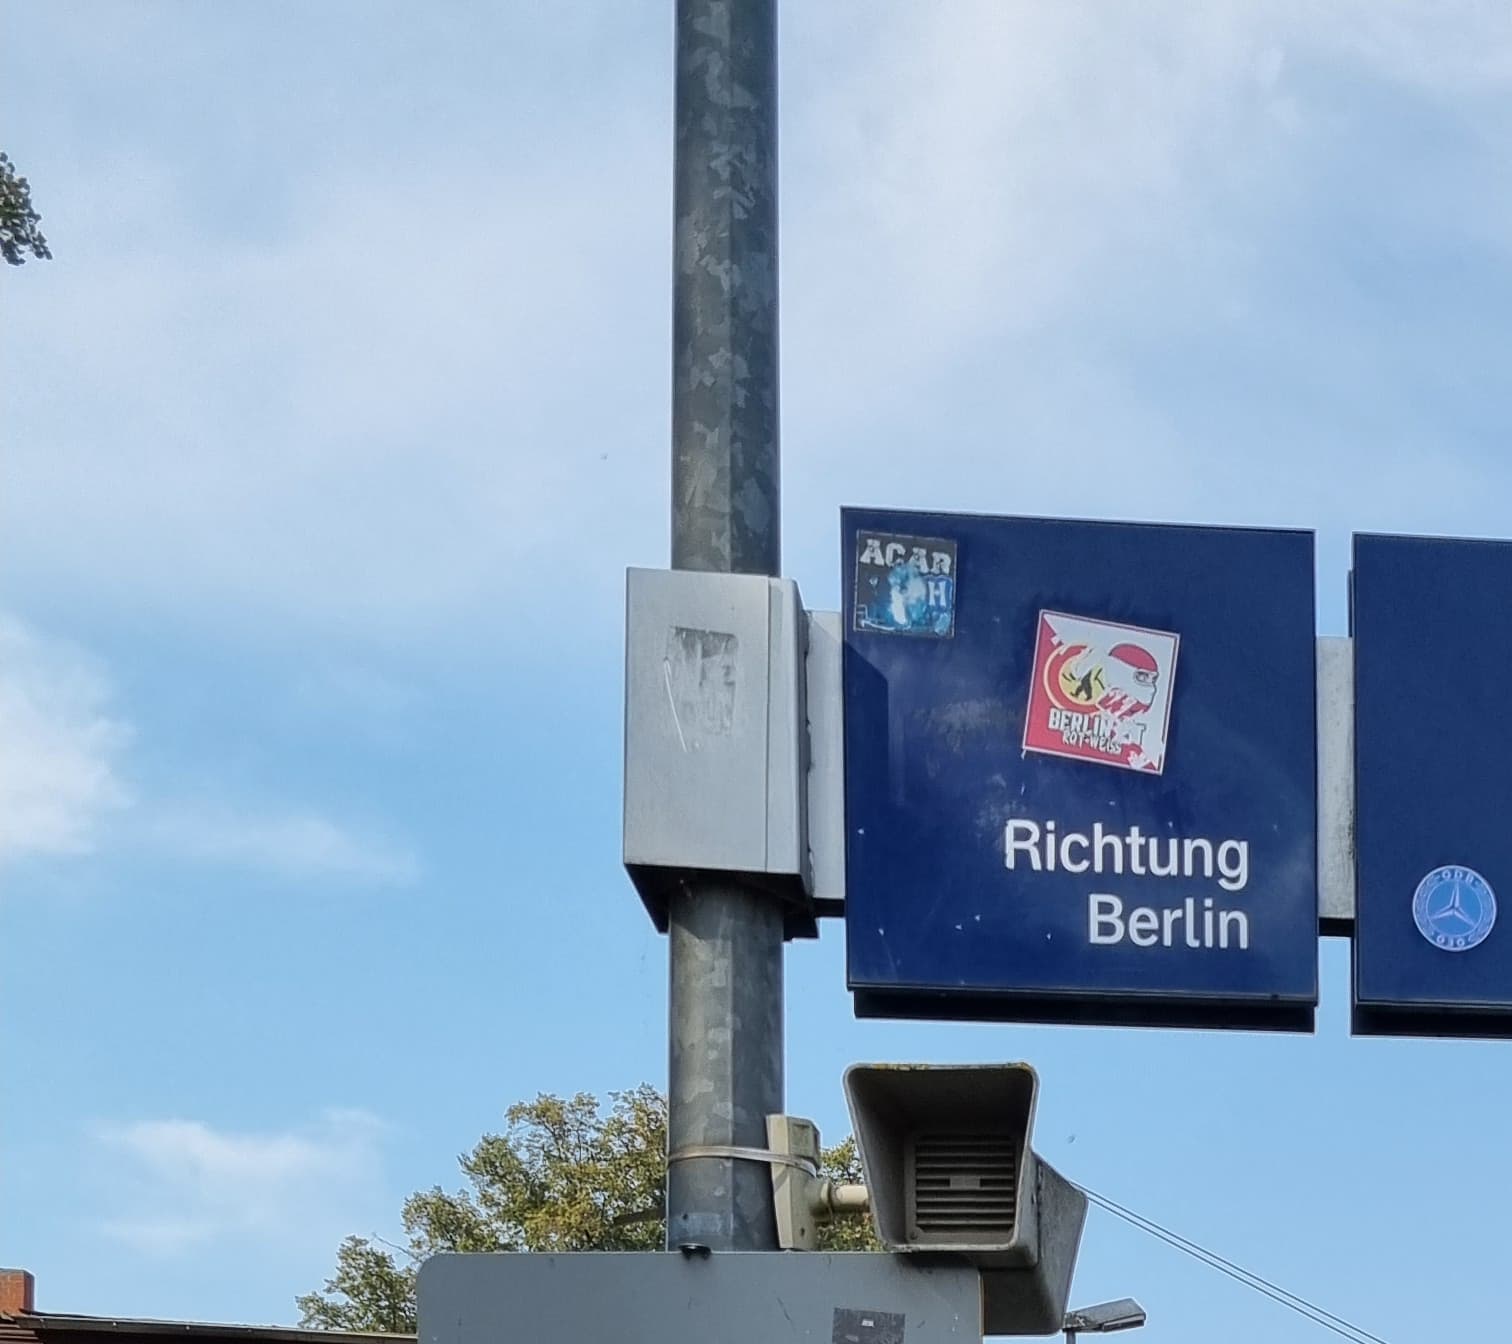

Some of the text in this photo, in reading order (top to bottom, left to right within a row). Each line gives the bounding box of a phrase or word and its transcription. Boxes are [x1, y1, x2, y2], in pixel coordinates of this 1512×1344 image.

[1048, 707, 1113, 738] BERLIN
[1004, 818, 1249, 892] Richtung
[1088, 893, 1249, 950] Berlin
